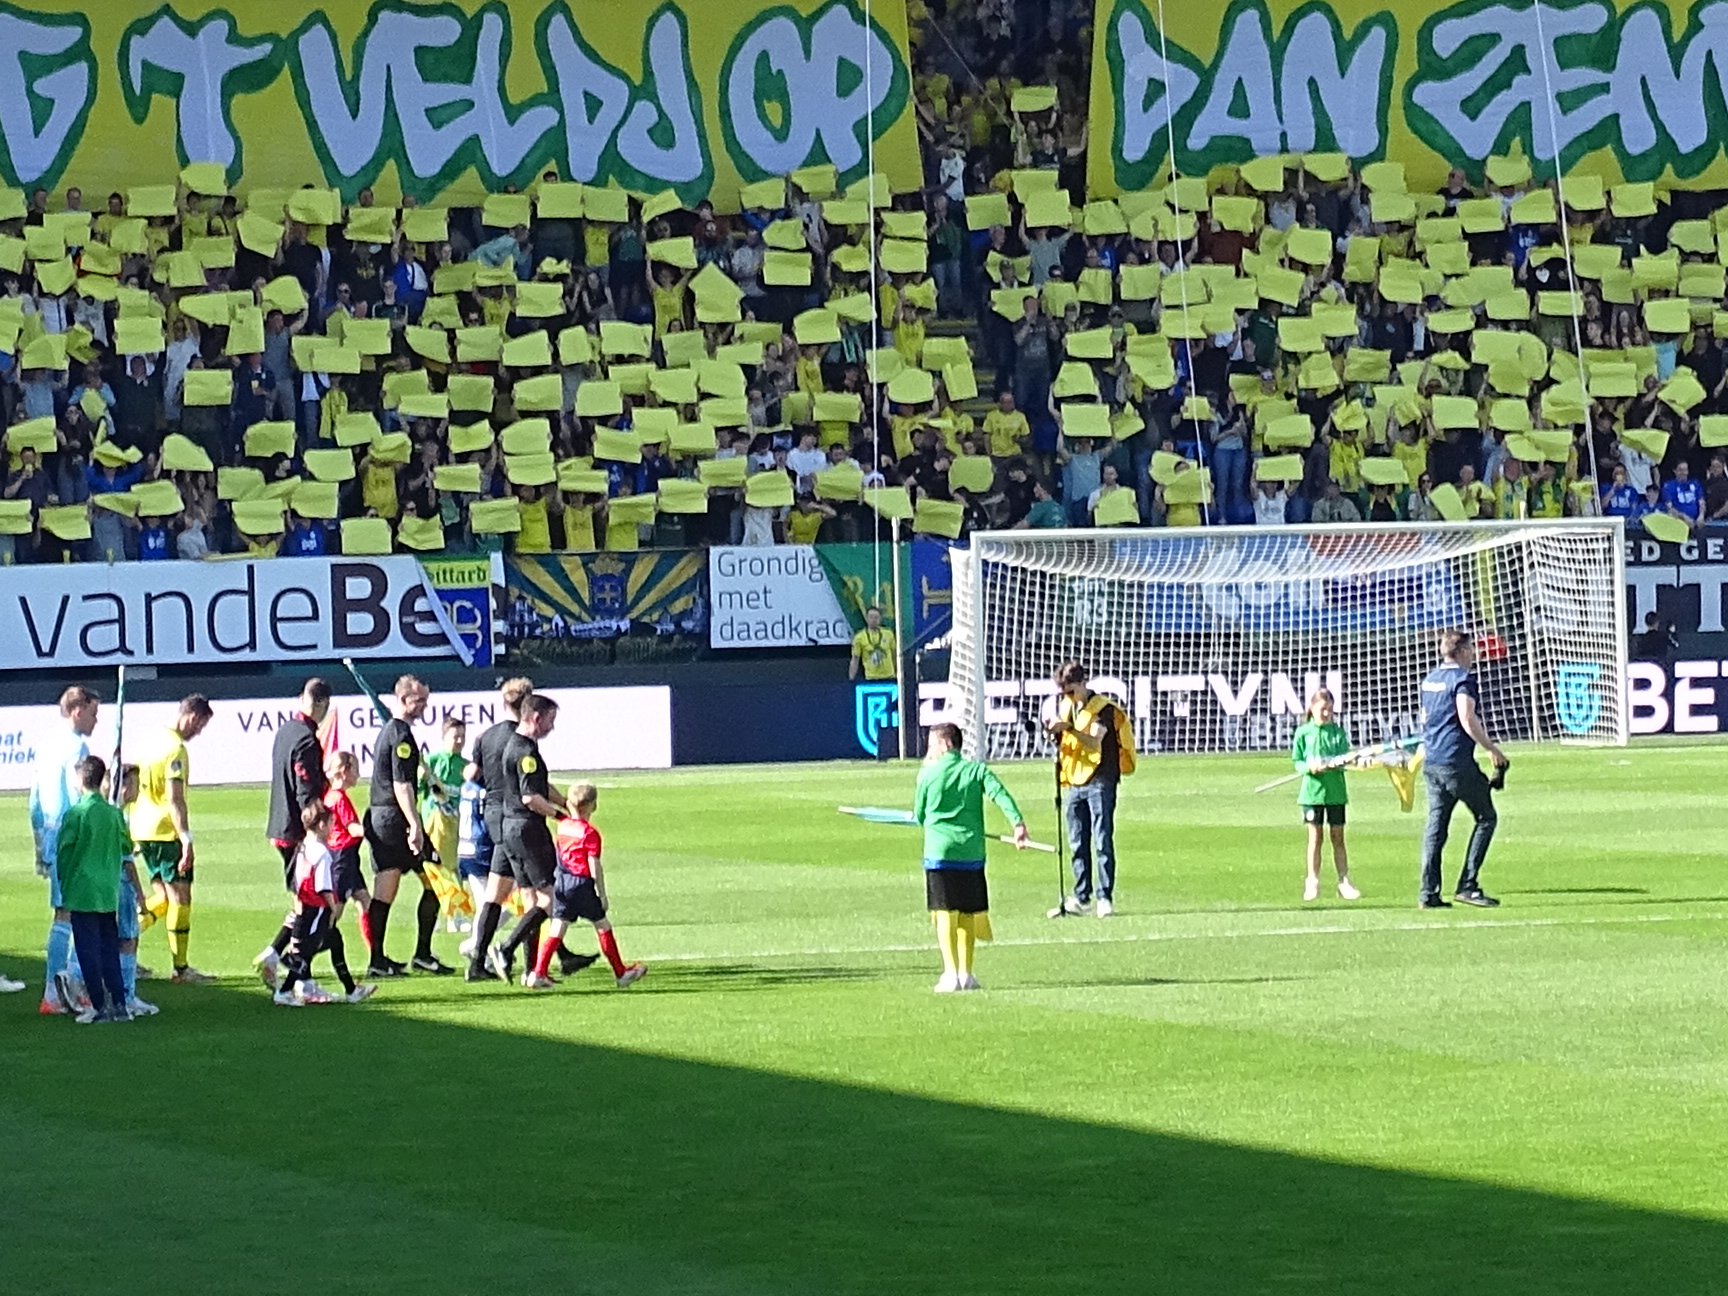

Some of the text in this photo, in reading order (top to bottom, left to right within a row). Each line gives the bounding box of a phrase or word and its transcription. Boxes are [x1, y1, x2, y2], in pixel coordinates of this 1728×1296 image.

[727, 3, 896, 172] OP
[1116, 4, 1392, 161] DAN
[716, 551, 824, 584] Grondig
[716, 587, 774, 611] met
[718, 615, 850, 645] daadkrac
